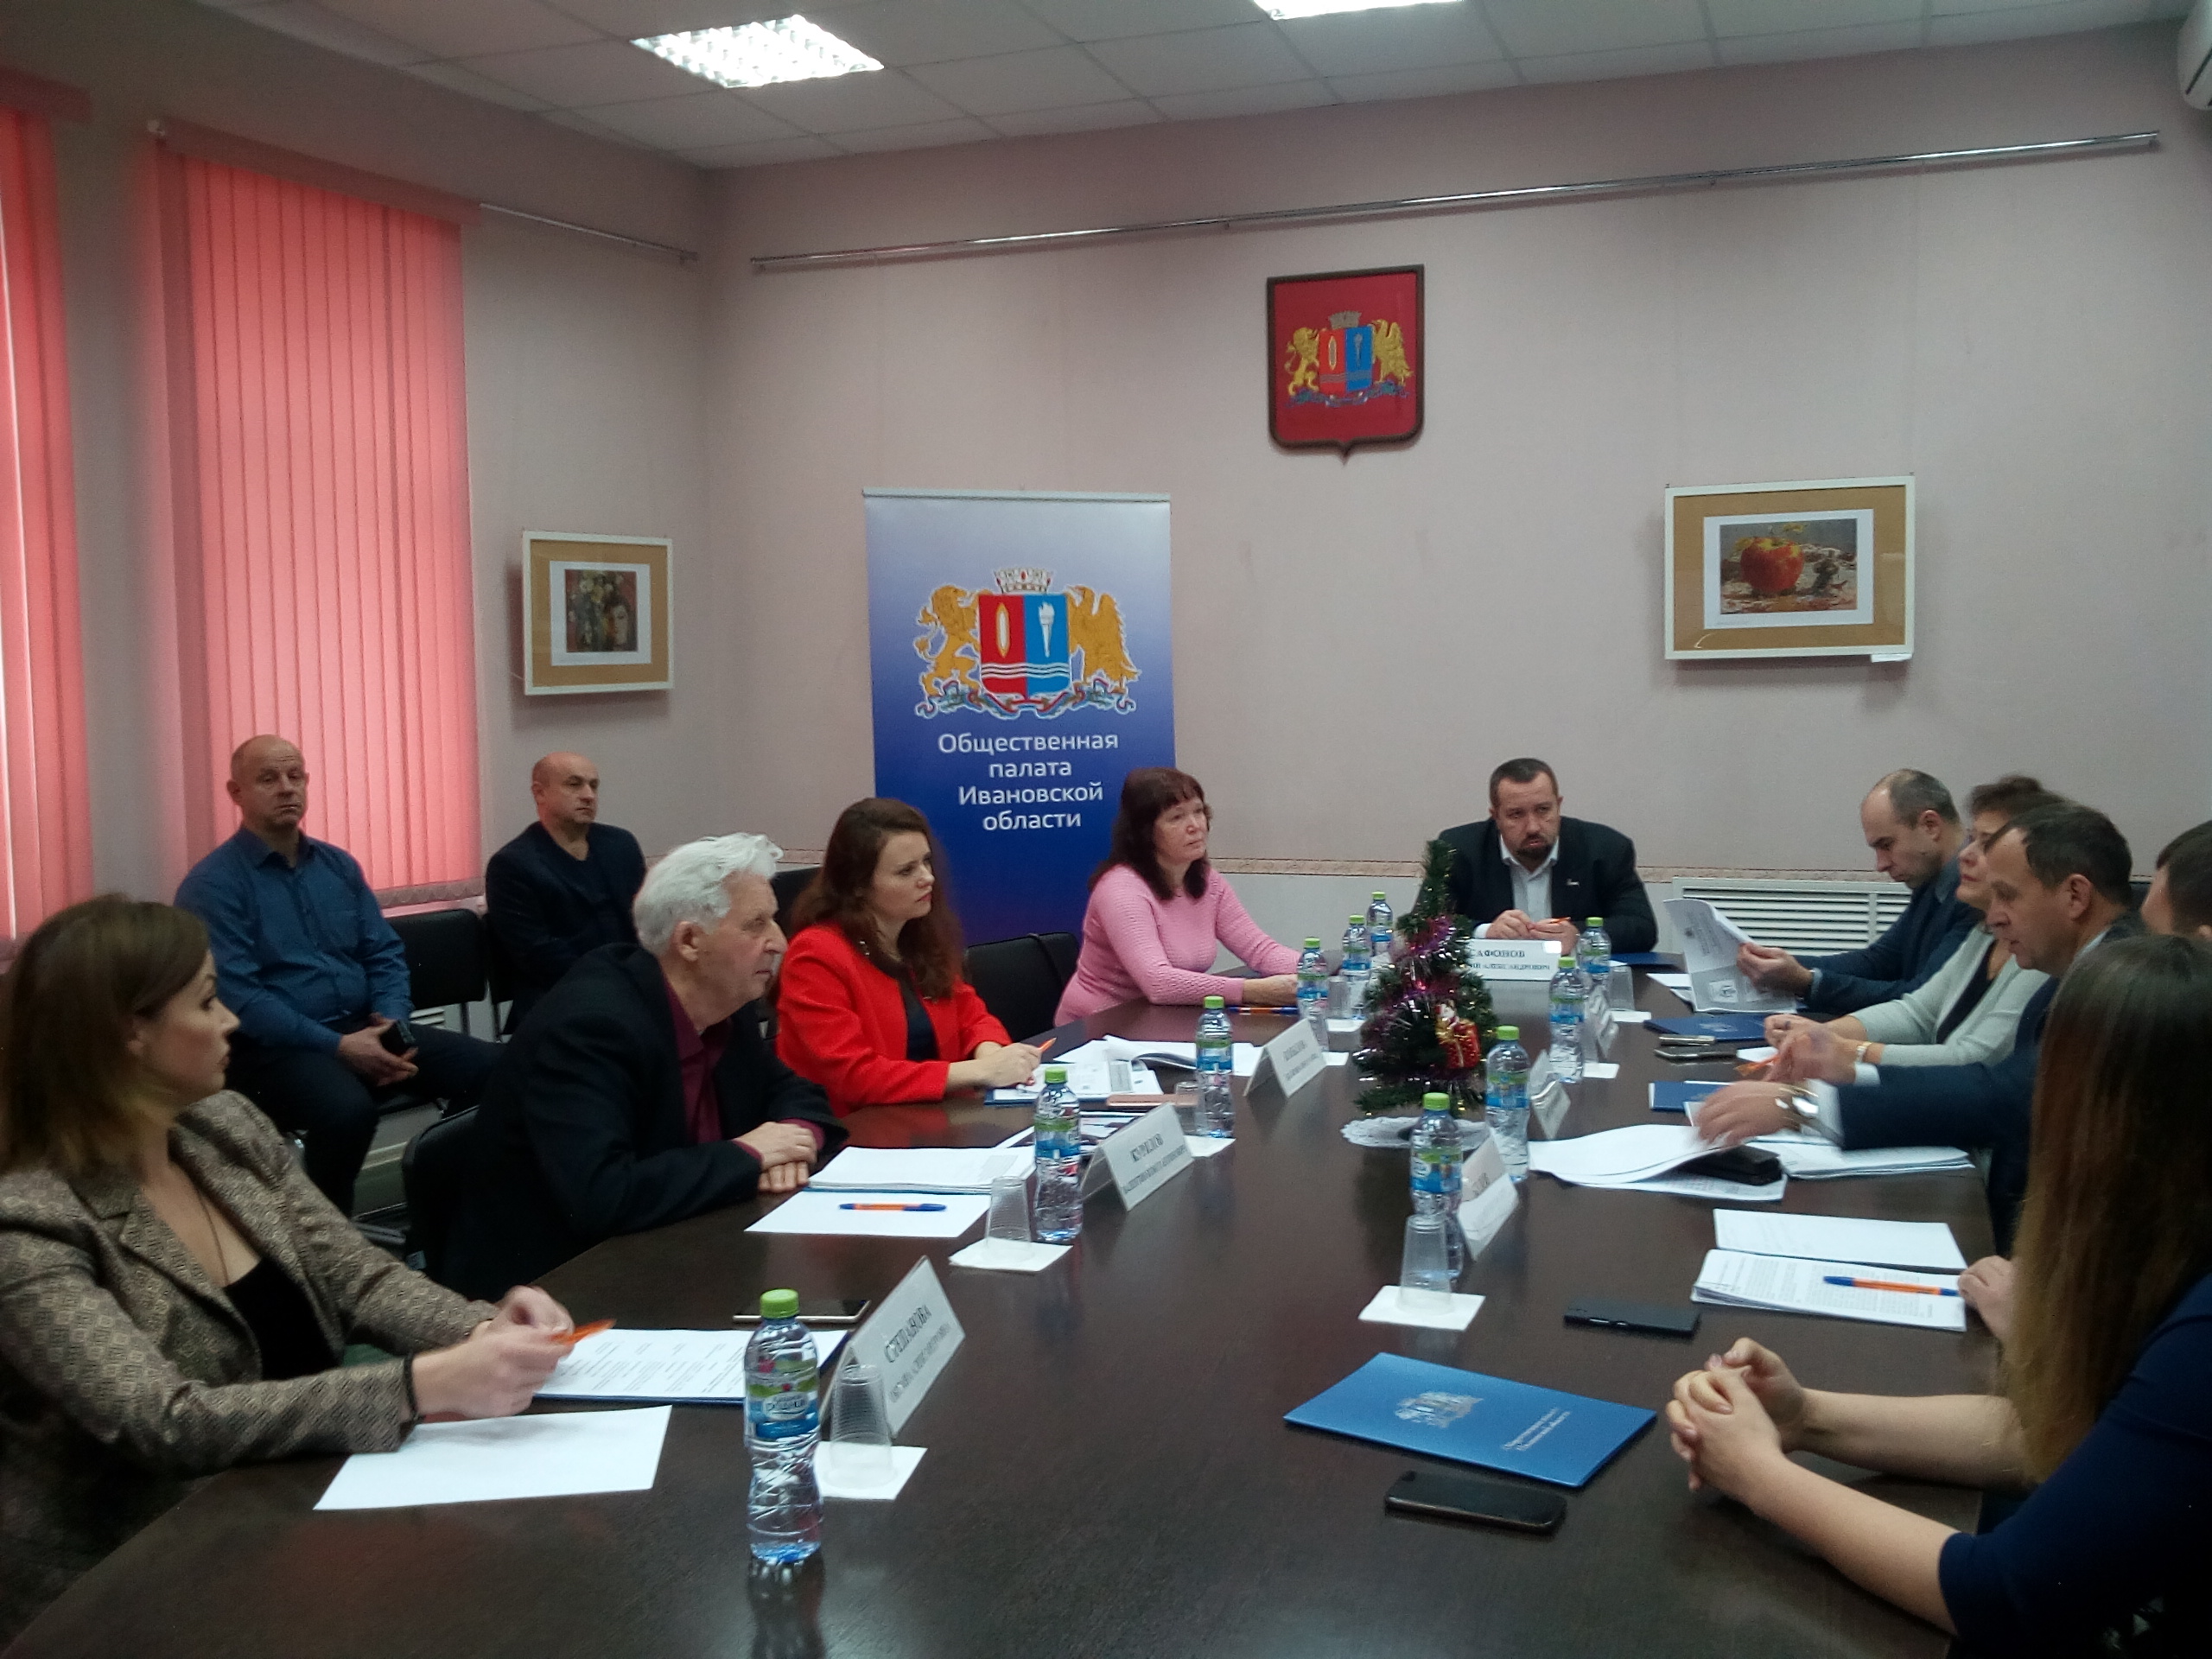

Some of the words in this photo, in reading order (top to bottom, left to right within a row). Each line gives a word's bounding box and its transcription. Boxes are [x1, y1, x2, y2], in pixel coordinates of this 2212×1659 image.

[938, 733, 1119, 755] Общественная
[988, 761, 1071, 778] палата
[957, 781, 1103, 805] Ивановской
[982, 810, 1081, 831] области
